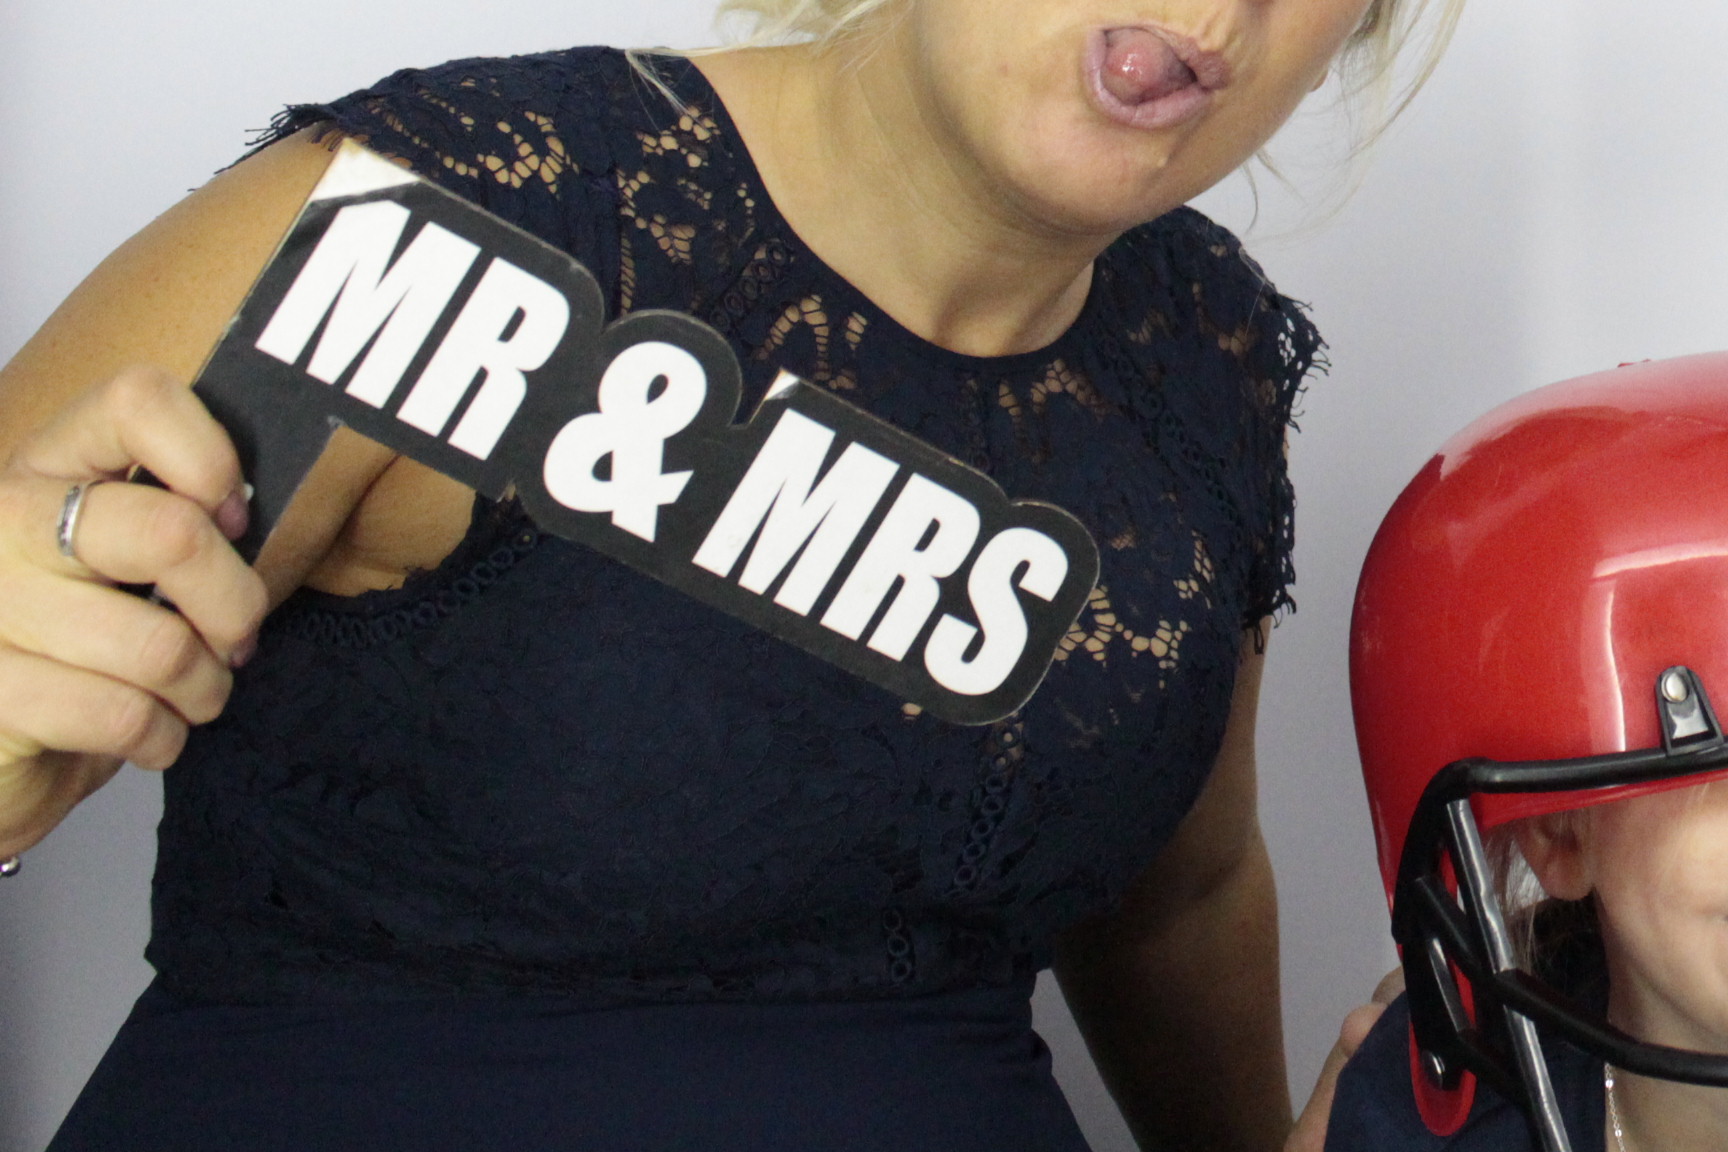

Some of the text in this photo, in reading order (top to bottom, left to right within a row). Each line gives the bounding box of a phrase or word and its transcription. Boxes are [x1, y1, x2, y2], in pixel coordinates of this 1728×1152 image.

[255, 200, 1069, 696] MR & MRS
